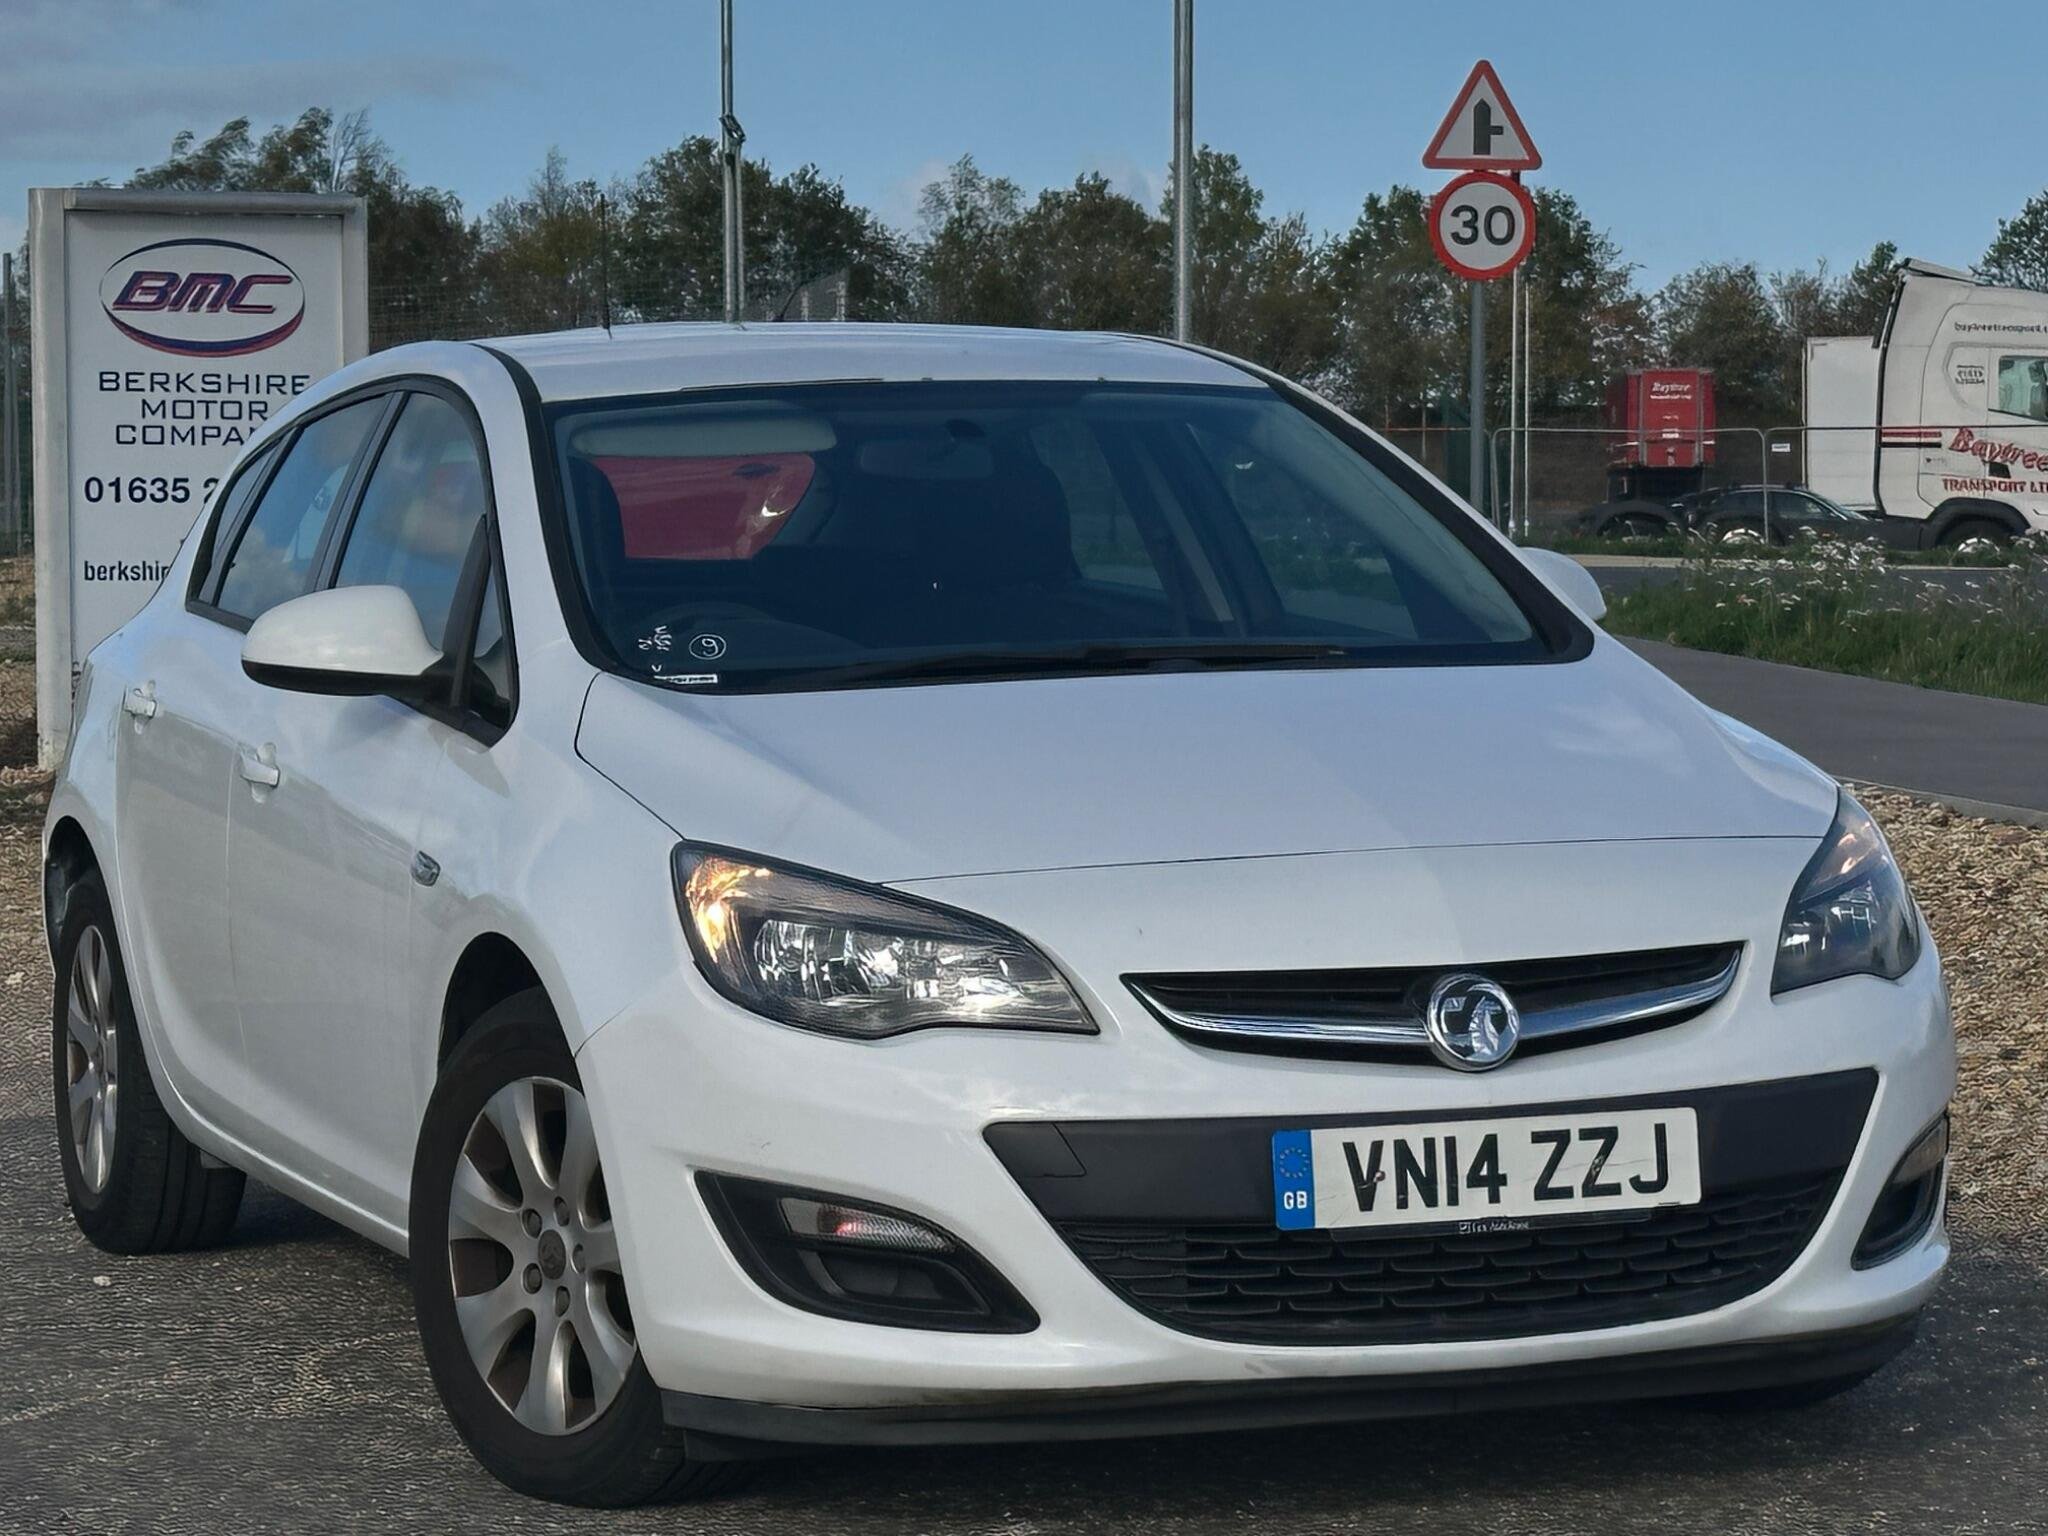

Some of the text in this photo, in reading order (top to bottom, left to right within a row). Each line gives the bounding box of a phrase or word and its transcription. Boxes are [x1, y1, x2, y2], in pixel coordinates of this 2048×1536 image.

[1451, 204, 1516, 246] 30
[112, 271, 293, 314] BMC
[99, 371, 311, 396] BERKSHIRE
[141, 398, 269, 422] MOTOR
[116, 424, 256, 446] COMPA
[84, 476, 191, 503] 01635
[1943, 478, 2027, 493] TRANSPORT
[1342, 1122, 1669, 1213] VN14 ZZJ
[1283, 1191, 1308, 1210] GB
